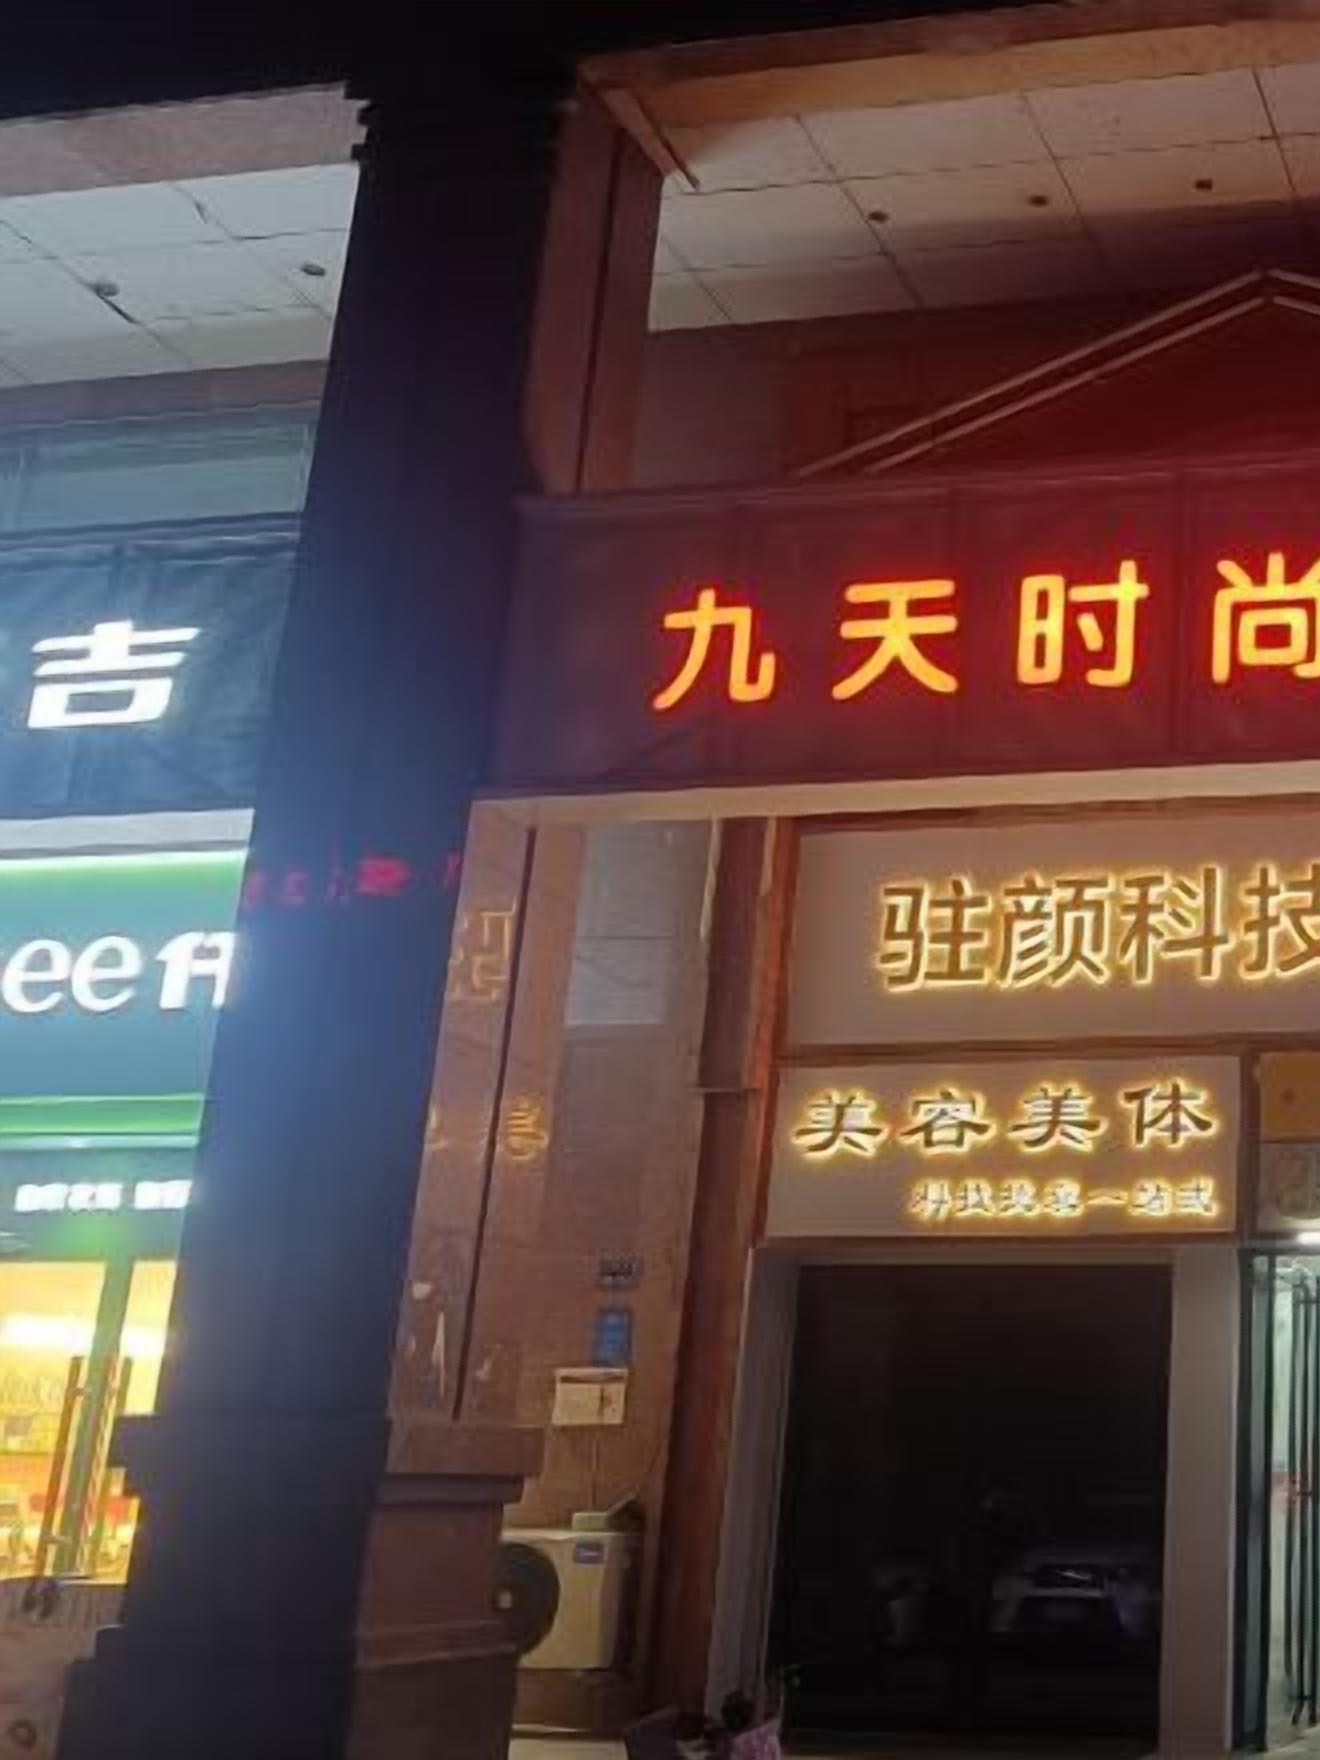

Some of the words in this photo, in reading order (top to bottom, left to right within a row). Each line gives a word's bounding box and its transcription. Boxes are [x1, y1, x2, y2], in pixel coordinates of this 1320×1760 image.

[28, 620, 200, 729] 吉
[792, 1078, 1218, 1160] 美容美体
